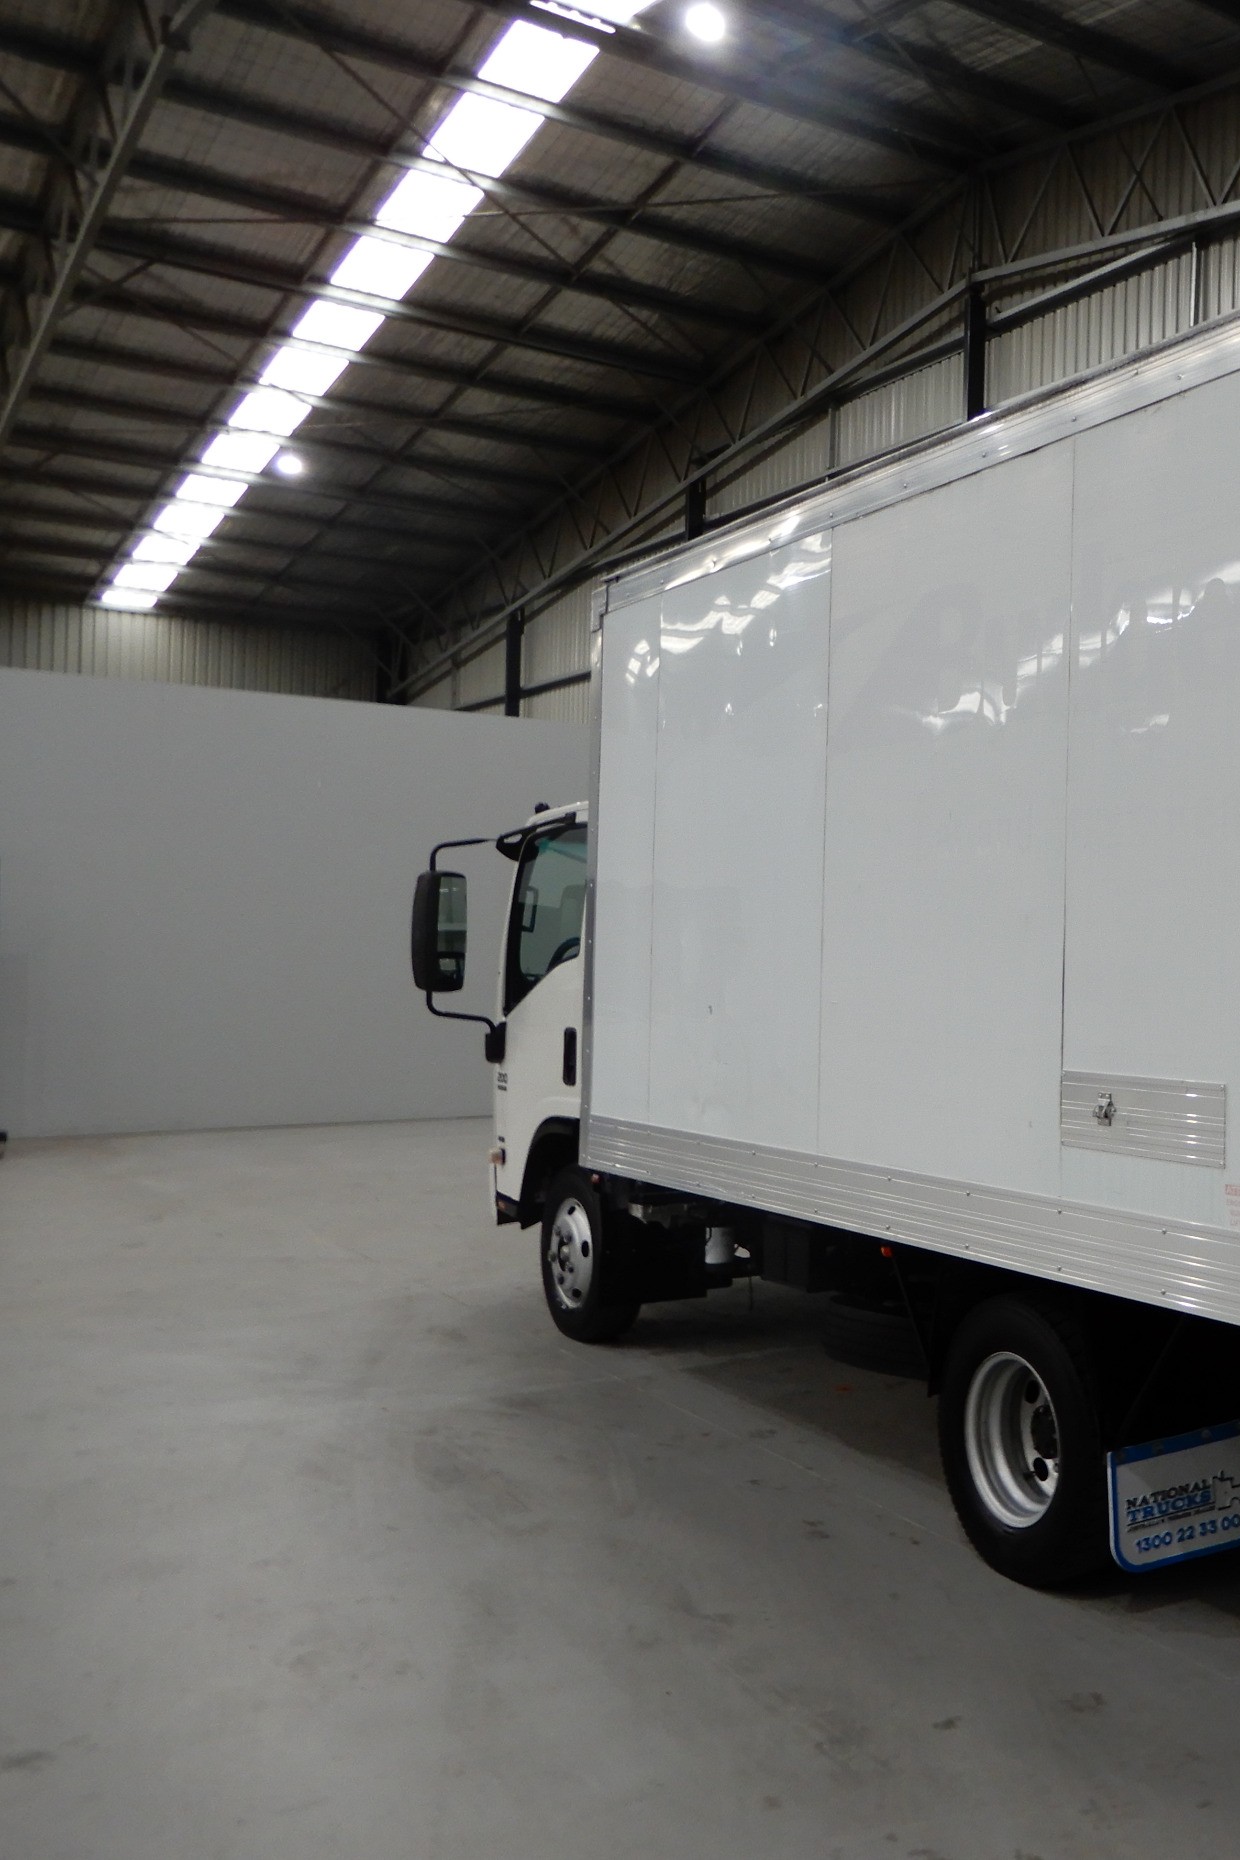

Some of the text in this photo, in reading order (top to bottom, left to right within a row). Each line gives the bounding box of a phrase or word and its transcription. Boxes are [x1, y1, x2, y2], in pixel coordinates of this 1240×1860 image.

[1126, 1479, 1211, 1509] NATIONAL
[1127, 1490, 1212, 1522] TRUCKS
[1136, 1531, 1173, 1553] 1300
[1177, 1526, 1195, 1543] 22
[1200, 1520, 1218, 1536] 33
